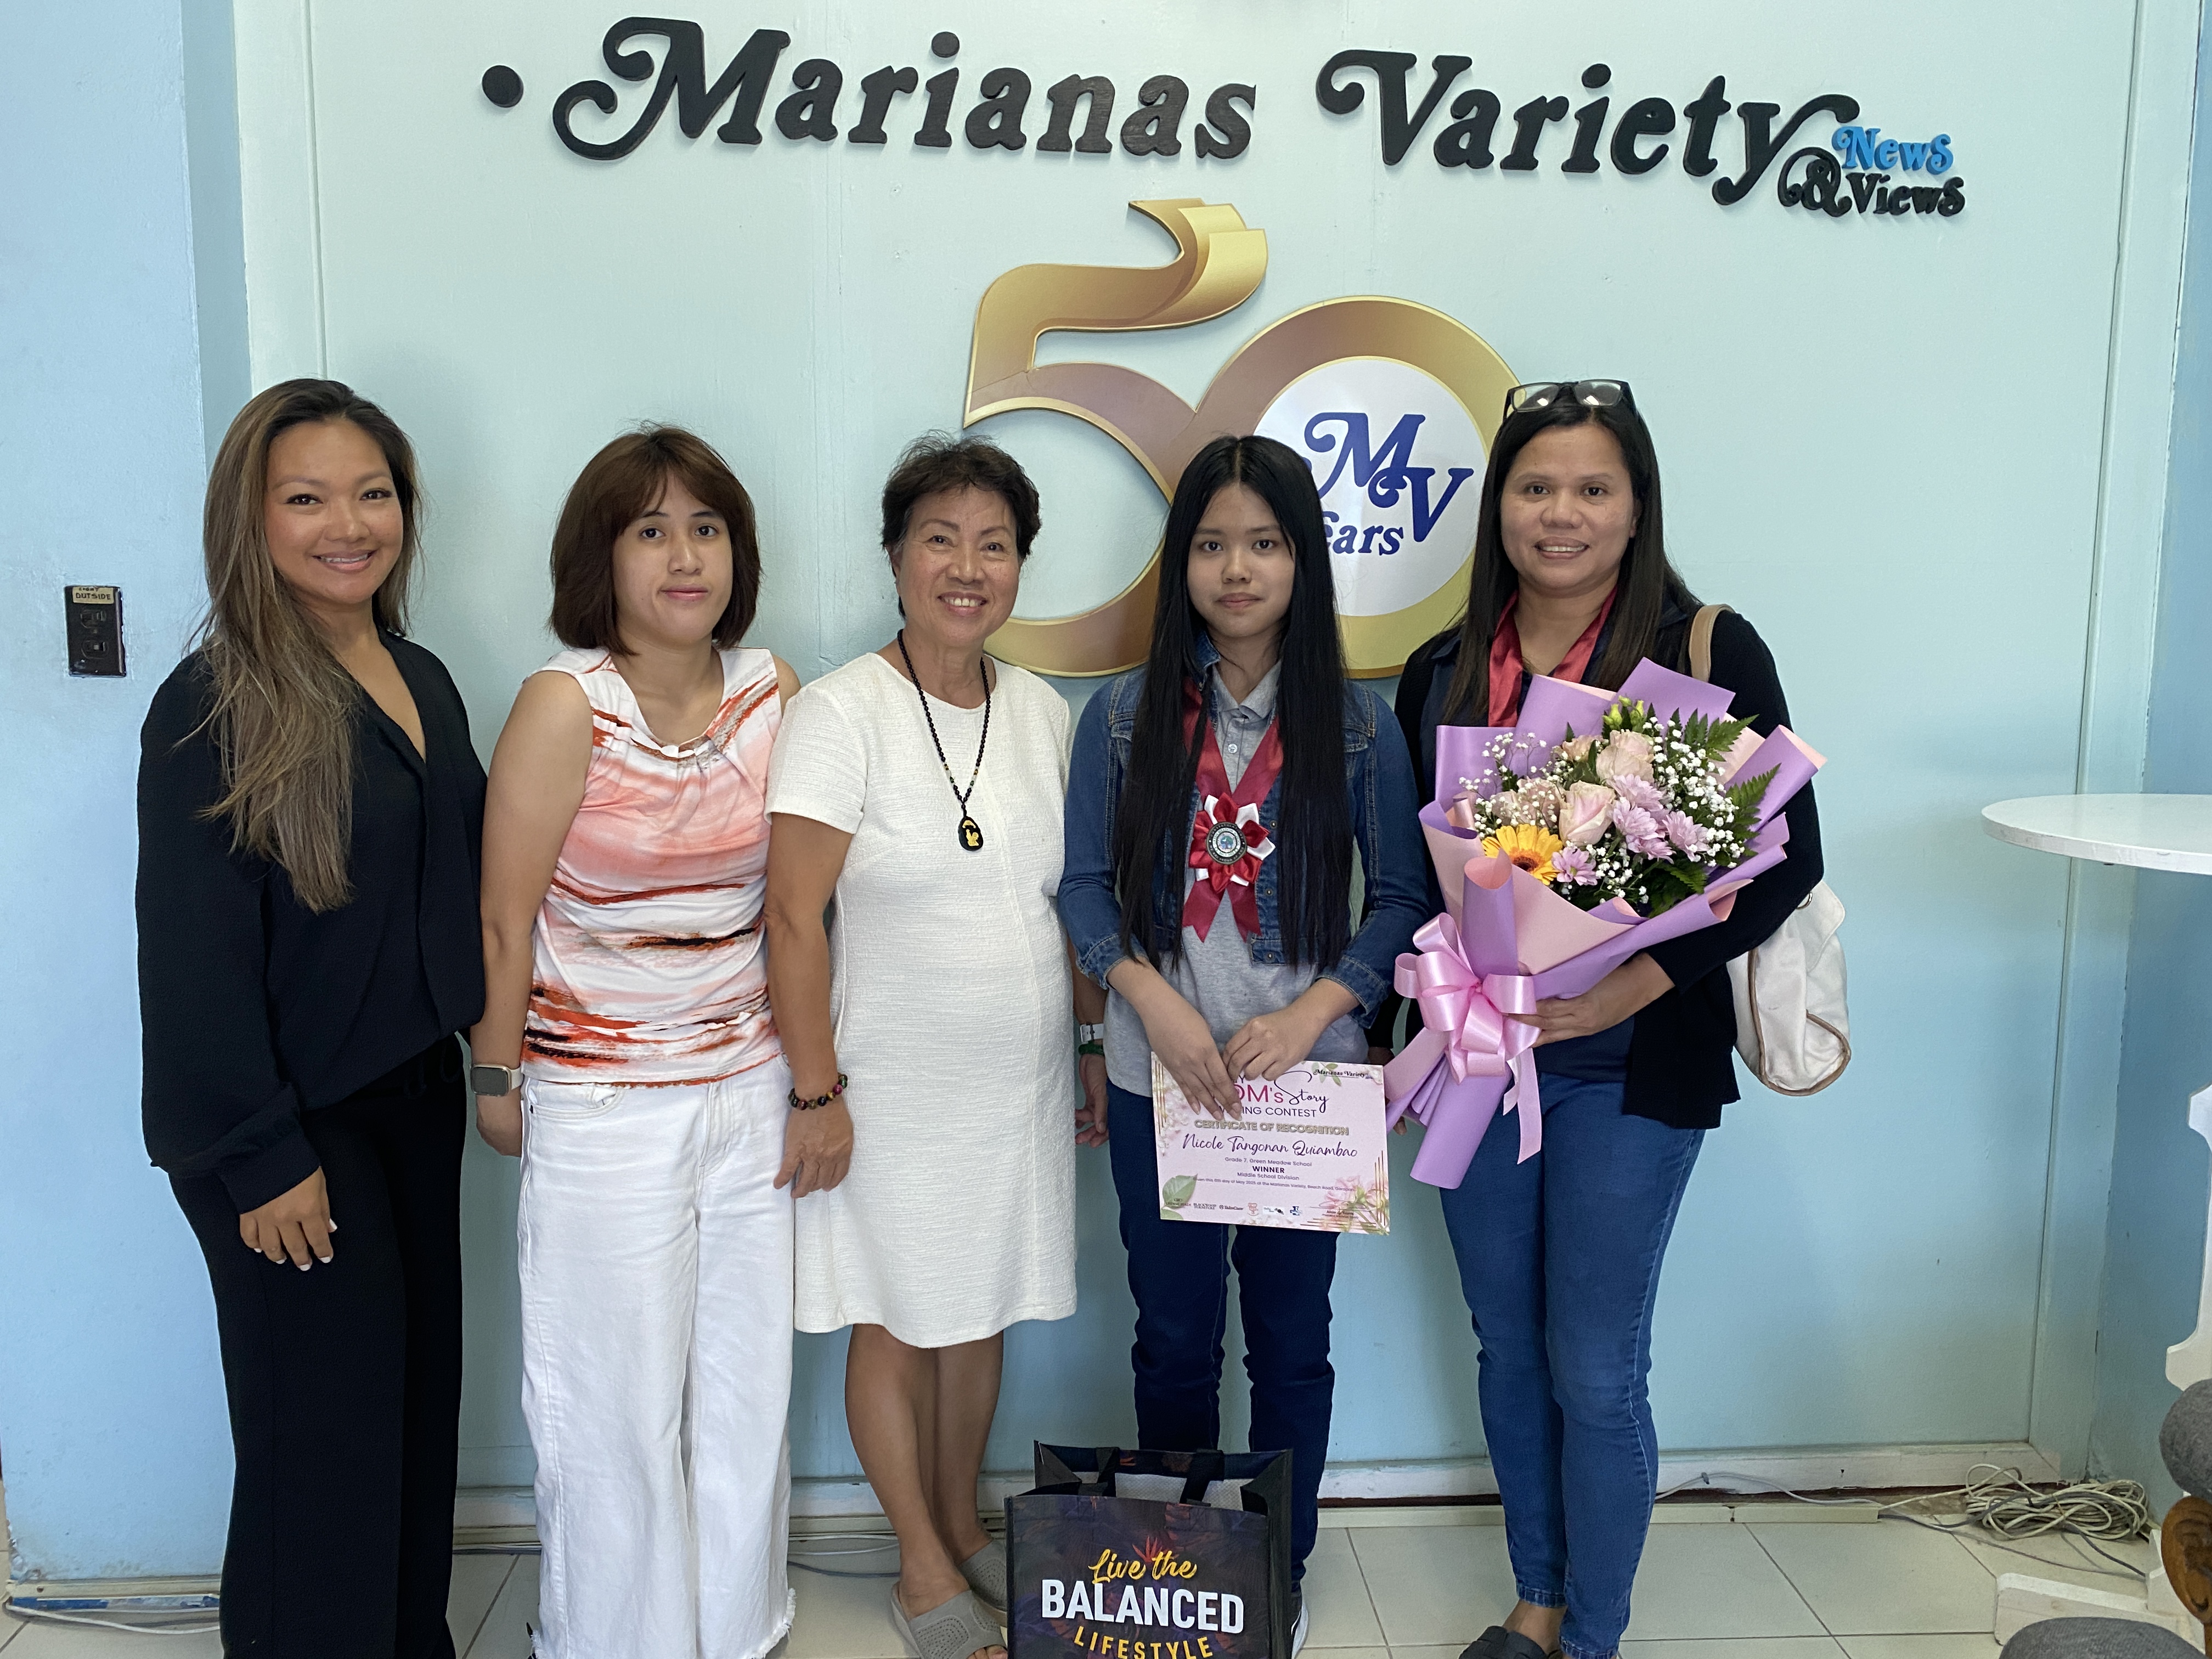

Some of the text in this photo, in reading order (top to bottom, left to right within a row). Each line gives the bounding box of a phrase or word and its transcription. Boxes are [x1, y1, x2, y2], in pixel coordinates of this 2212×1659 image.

[552, 16, 1860, 205] Marianas Variety
[1323, 511, 1403, 556] ars
[1234, 1070, 1330, 1113] OM's Story
[1194, 1119, 1350, 1136] CERTIFICATE OF RECOGNITION
[1265, 1107, 1317, 1117] CONTEST
[1182, 1133, 1358, 1157] Nicole Tangonan Quiambao
[1252, 1165, 1285, 1173] WINNER
[1088, 1549, 1197, 1584] Live the
[1041, 1579, 1244, 1634] BALANCED
[1074, 1626, 1214, 1659] LIFESTYLE
